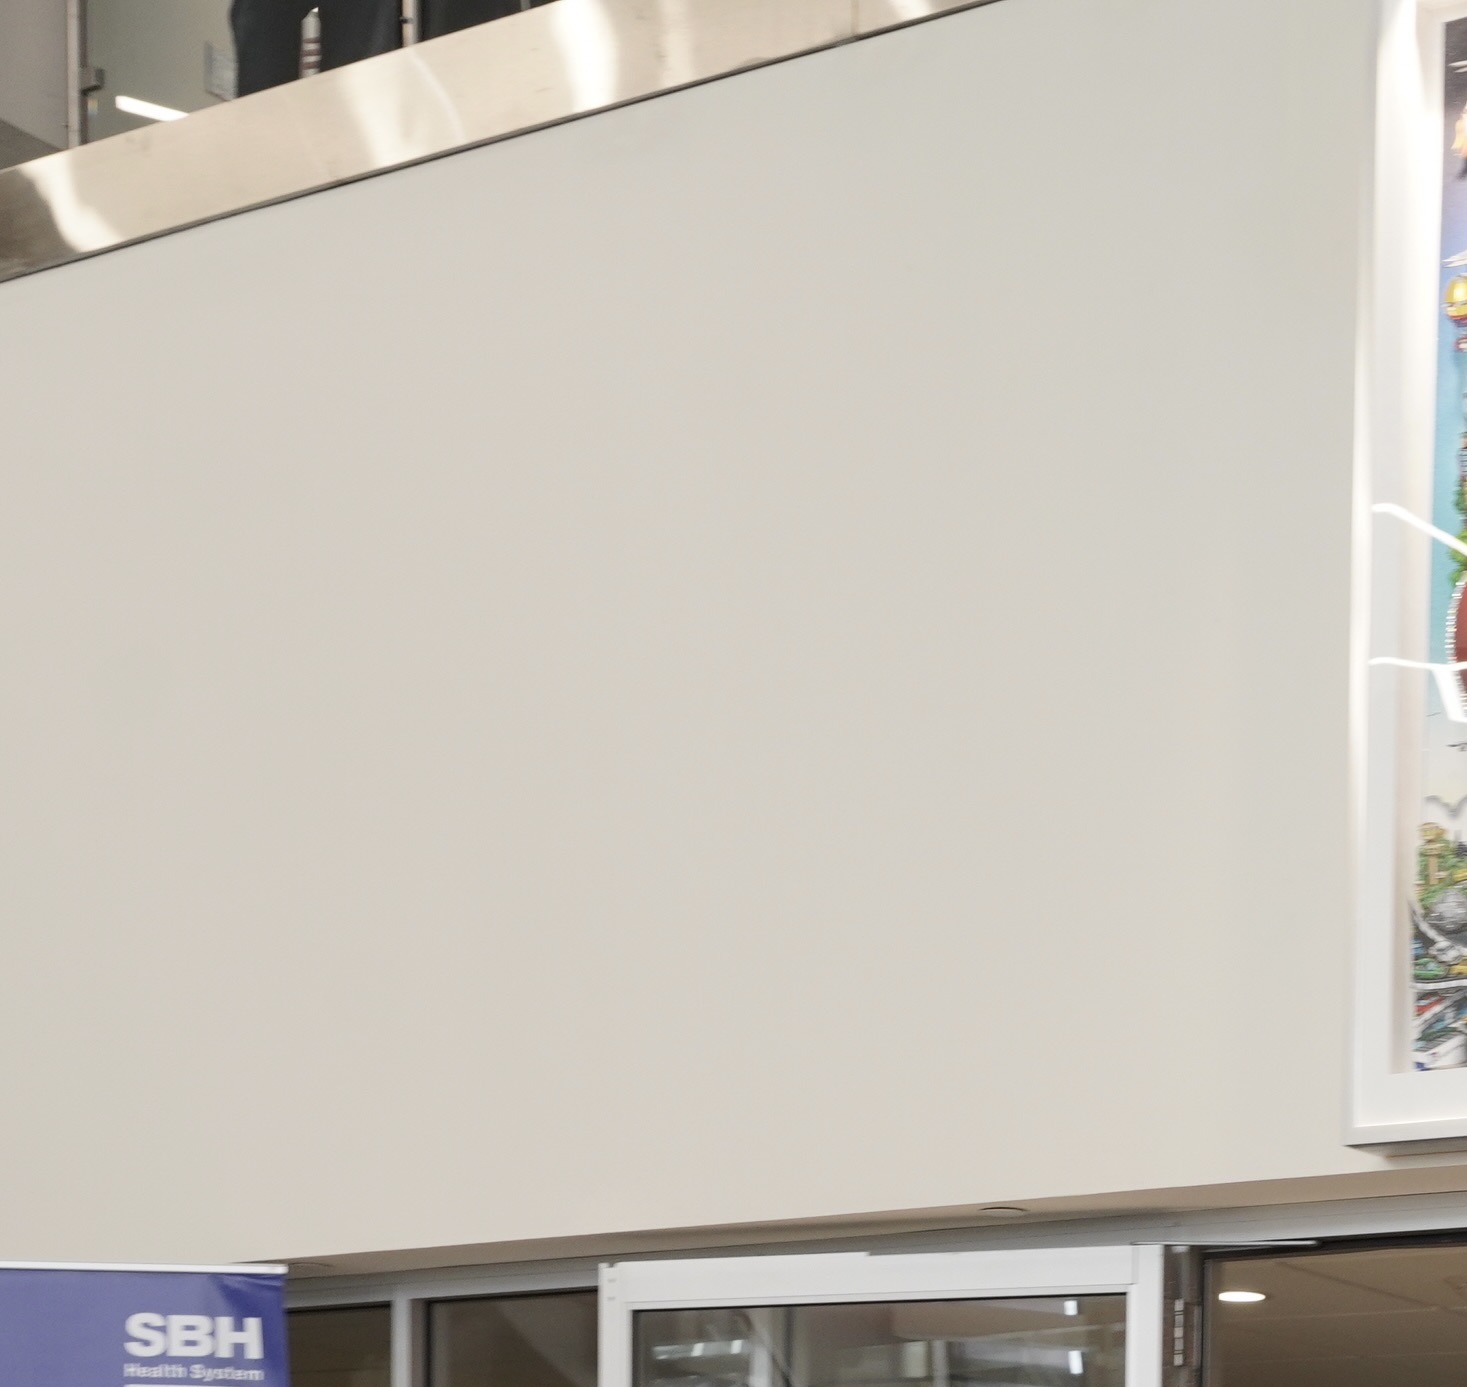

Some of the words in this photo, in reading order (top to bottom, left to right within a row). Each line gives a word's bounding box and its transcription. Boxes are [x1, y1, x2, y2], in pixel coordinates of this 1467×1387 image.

[124, 1312, 264, 1360] SBH
[123, 1363, 187, 1378] Health
[189, 1364, 265, 1382] System
